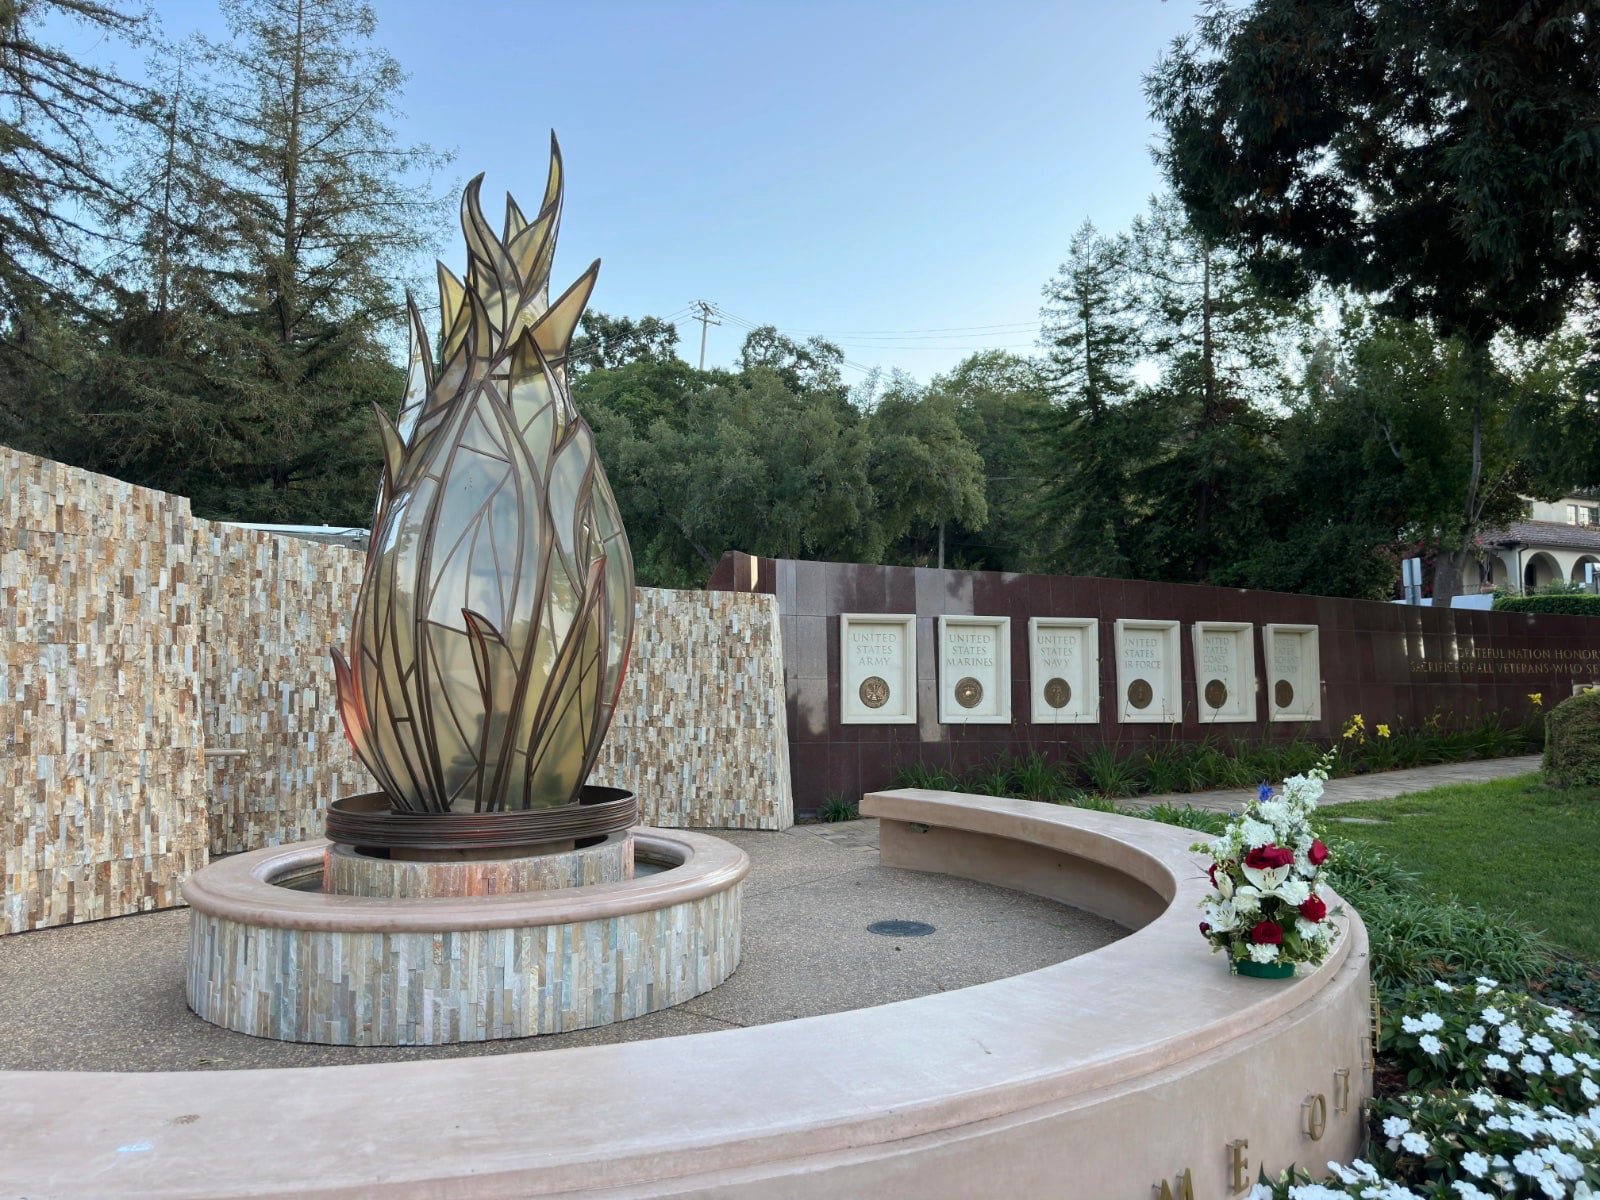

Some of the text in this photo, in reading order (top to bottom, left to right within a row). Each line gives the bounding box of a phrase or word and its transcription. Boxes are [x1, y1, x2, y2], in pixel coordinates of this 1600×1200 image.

[853, 633, 896, 643] UNITED
[949, 634, 991, 644] UNITED
[1037, 635, 1077, 645] UNITED
[1203, 636, 1230, 646] NITED
[856, 645, 893, 655] STATES
[952, 646, 987, 656] STATES
[1040, 647, 1073, 657] STATES
[1124, 649, 1154, 659] STATES
[1203, 646, 1229, 655] TATES
[1508, 648, 1551, 660] NATION
[1555, 649, 1600, 660] HONOR
[858, 657, 891, 666] ARMY
[947, 657, 993, 667] MARINES
[1044, 659, 1070, 668] NAVY
[1135, 660, 1161, 670] FORCE
[1461, 662, 1475, 673] OF
[1477, 662, 1495, 674] ALL
[1497, 663, 1550, 673] VETERANS
[1553, 663, 1583, 674] WHO
